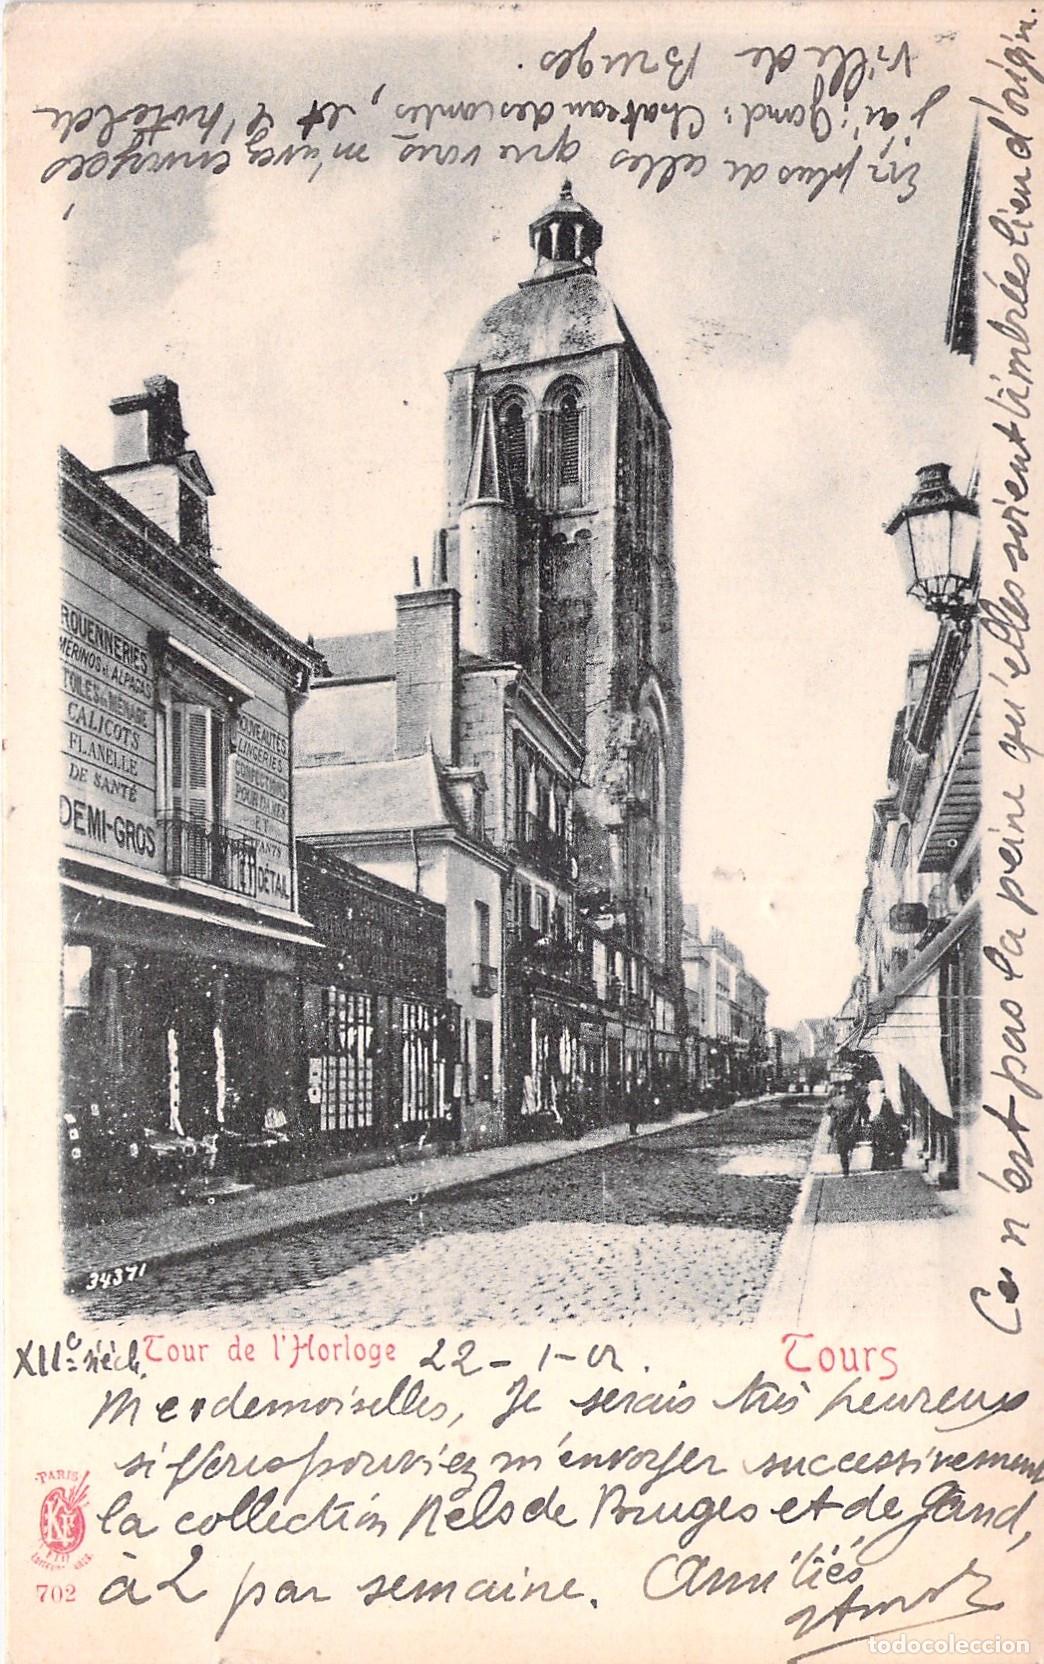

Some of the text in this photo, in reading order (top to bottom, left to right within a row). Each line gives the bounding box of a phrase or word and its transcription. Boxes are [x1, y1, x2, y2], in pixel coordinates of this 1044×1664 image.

[61, 604, 149, 675] ROUENNERIES
[67, 701, 140, 750] CALICOTS
[69, 732, 139, 777] FLANELLE
[69, 762, 138, 803] DE SANTÉ
[60, 795, 157, 859] DEMI-GROS
[86, 1263, 147, 1290] 34371
[144, 1334, 397, 1369] Tour de l'Horloge
[782, 1333, 898, 1380] Tours
[36, 1469, 79, 1484] PARIS
[36, 1584, 76, 1603] 702
